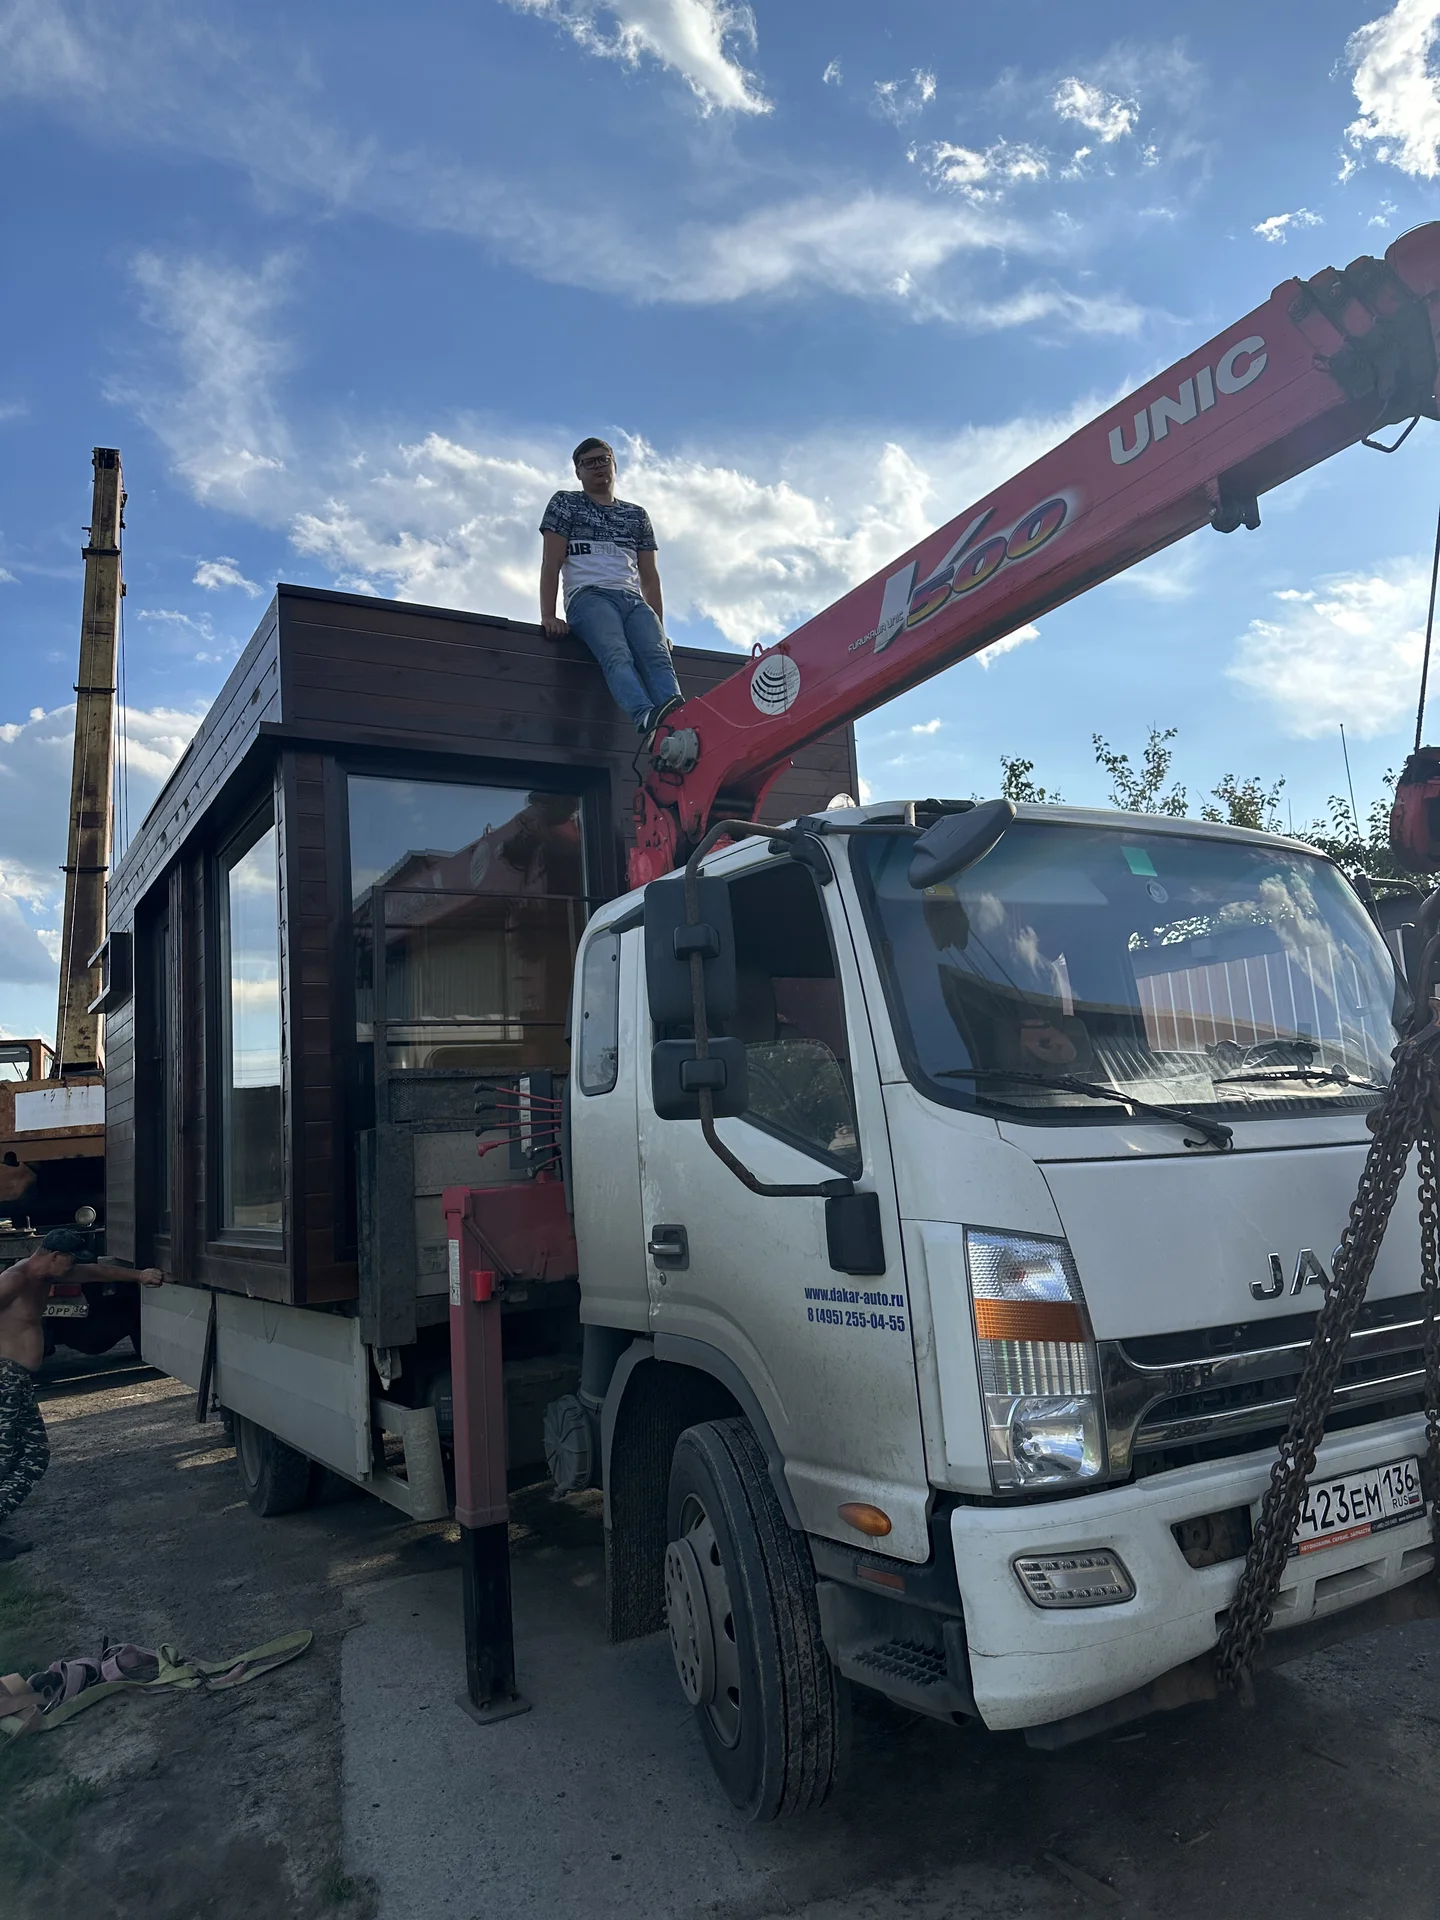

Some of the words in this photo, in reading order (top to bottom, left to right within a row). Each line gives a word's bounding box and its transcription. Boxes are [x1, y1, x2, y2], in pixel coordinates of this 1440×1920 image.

[1108, 335, 1268, 466] UNIC
[848, 624, 886, 652] FURUKAWA
[887, 612, 904, 628] UNIC
[1249, 1244, 1344, 1301] JA
[804, 1287, 904, 1307] www.dakar-auto.ru
[807, 1307, 814, 1322] 8
[816, 1308, 843, 1325] (495)
[845, 1311, 905, 1332] 255-04-55
[1293, 1484, 1382, 1536] 423ЕМ
[1383, 1463, 1415, 1498] 136
[1392, 1495, 1409, 1508] RUS
